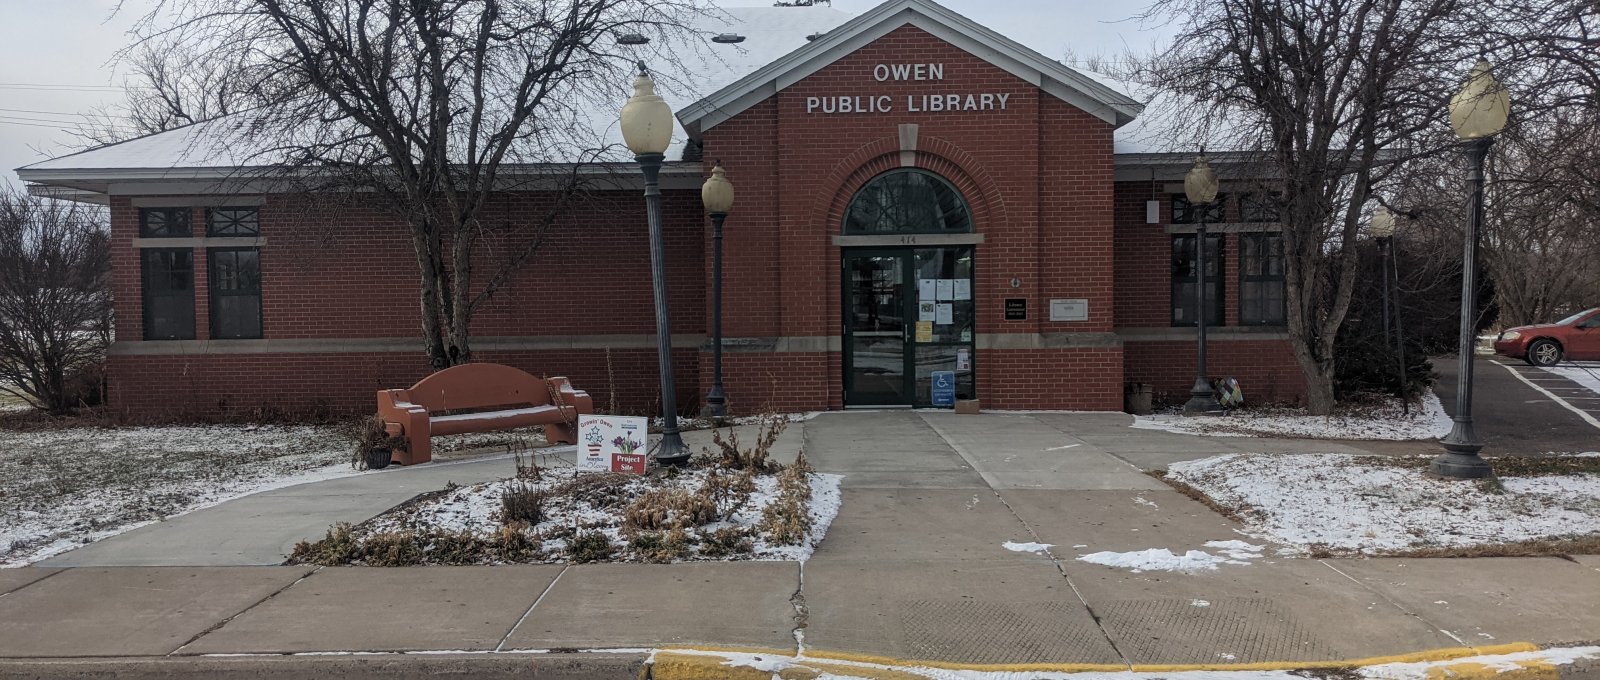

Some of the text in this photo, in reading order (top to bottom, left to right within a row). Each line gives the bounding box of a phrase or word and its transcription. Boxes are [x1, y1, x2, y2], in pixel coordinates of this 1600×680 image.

[873, 63, 944, 82] OWEN
[806, 93, 1010, 113] PUBLIC LIBRARY
[900, 236, 916, 244] 414
[599, 419, 613, 428] Owen
